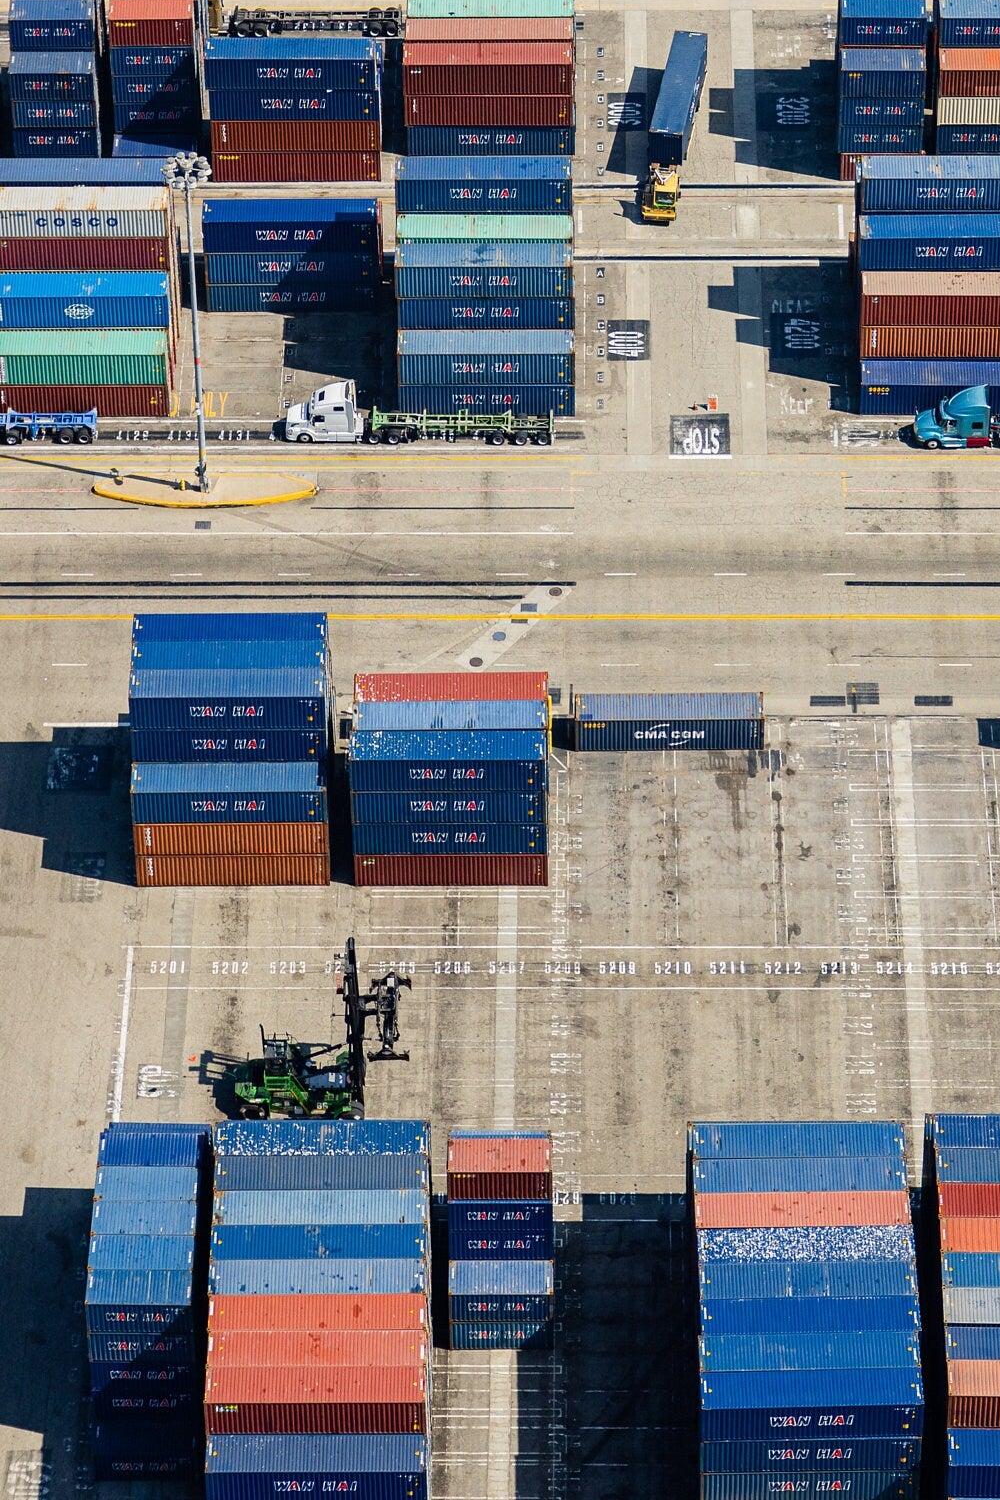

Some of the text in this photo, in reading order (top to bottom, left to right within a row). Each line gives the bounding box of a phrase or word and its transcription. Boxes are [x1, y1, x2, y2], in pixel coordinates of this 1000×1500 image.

[257, 68, 321, 78] WAN HAI
[776, 97, 811, 125] 3200
[459, 134, 522, 144] WAN HAI
[450, 188, 517, 198] WAN HAI
[917, 187, 984, 198] WAN HAI
[452, 307, 519, 317] WAN HAI
[784, 318, 821, 349] 4200
[683, 427, 720, 454] STOP
[190, 706, 263, 716] WAN HAI
[634, 730, 705, 739] CMA CGM
[191, 801, 265, 811] WAN HAI
[410, 801, 484, 811] WAN HAI
[150, 961, 185, 974] 5201
[212, 961, 249, 974] 5202
[599, 961, 636, 974] 5209
[654, 961, 691, 974] 5210
[821, 961, 857, 974] 5213
[931, 962, 968, 975] 5215
[770, 1415, 854, 1427] WAN HAI
[274, 1481, 357, 1491] WAN HAI
